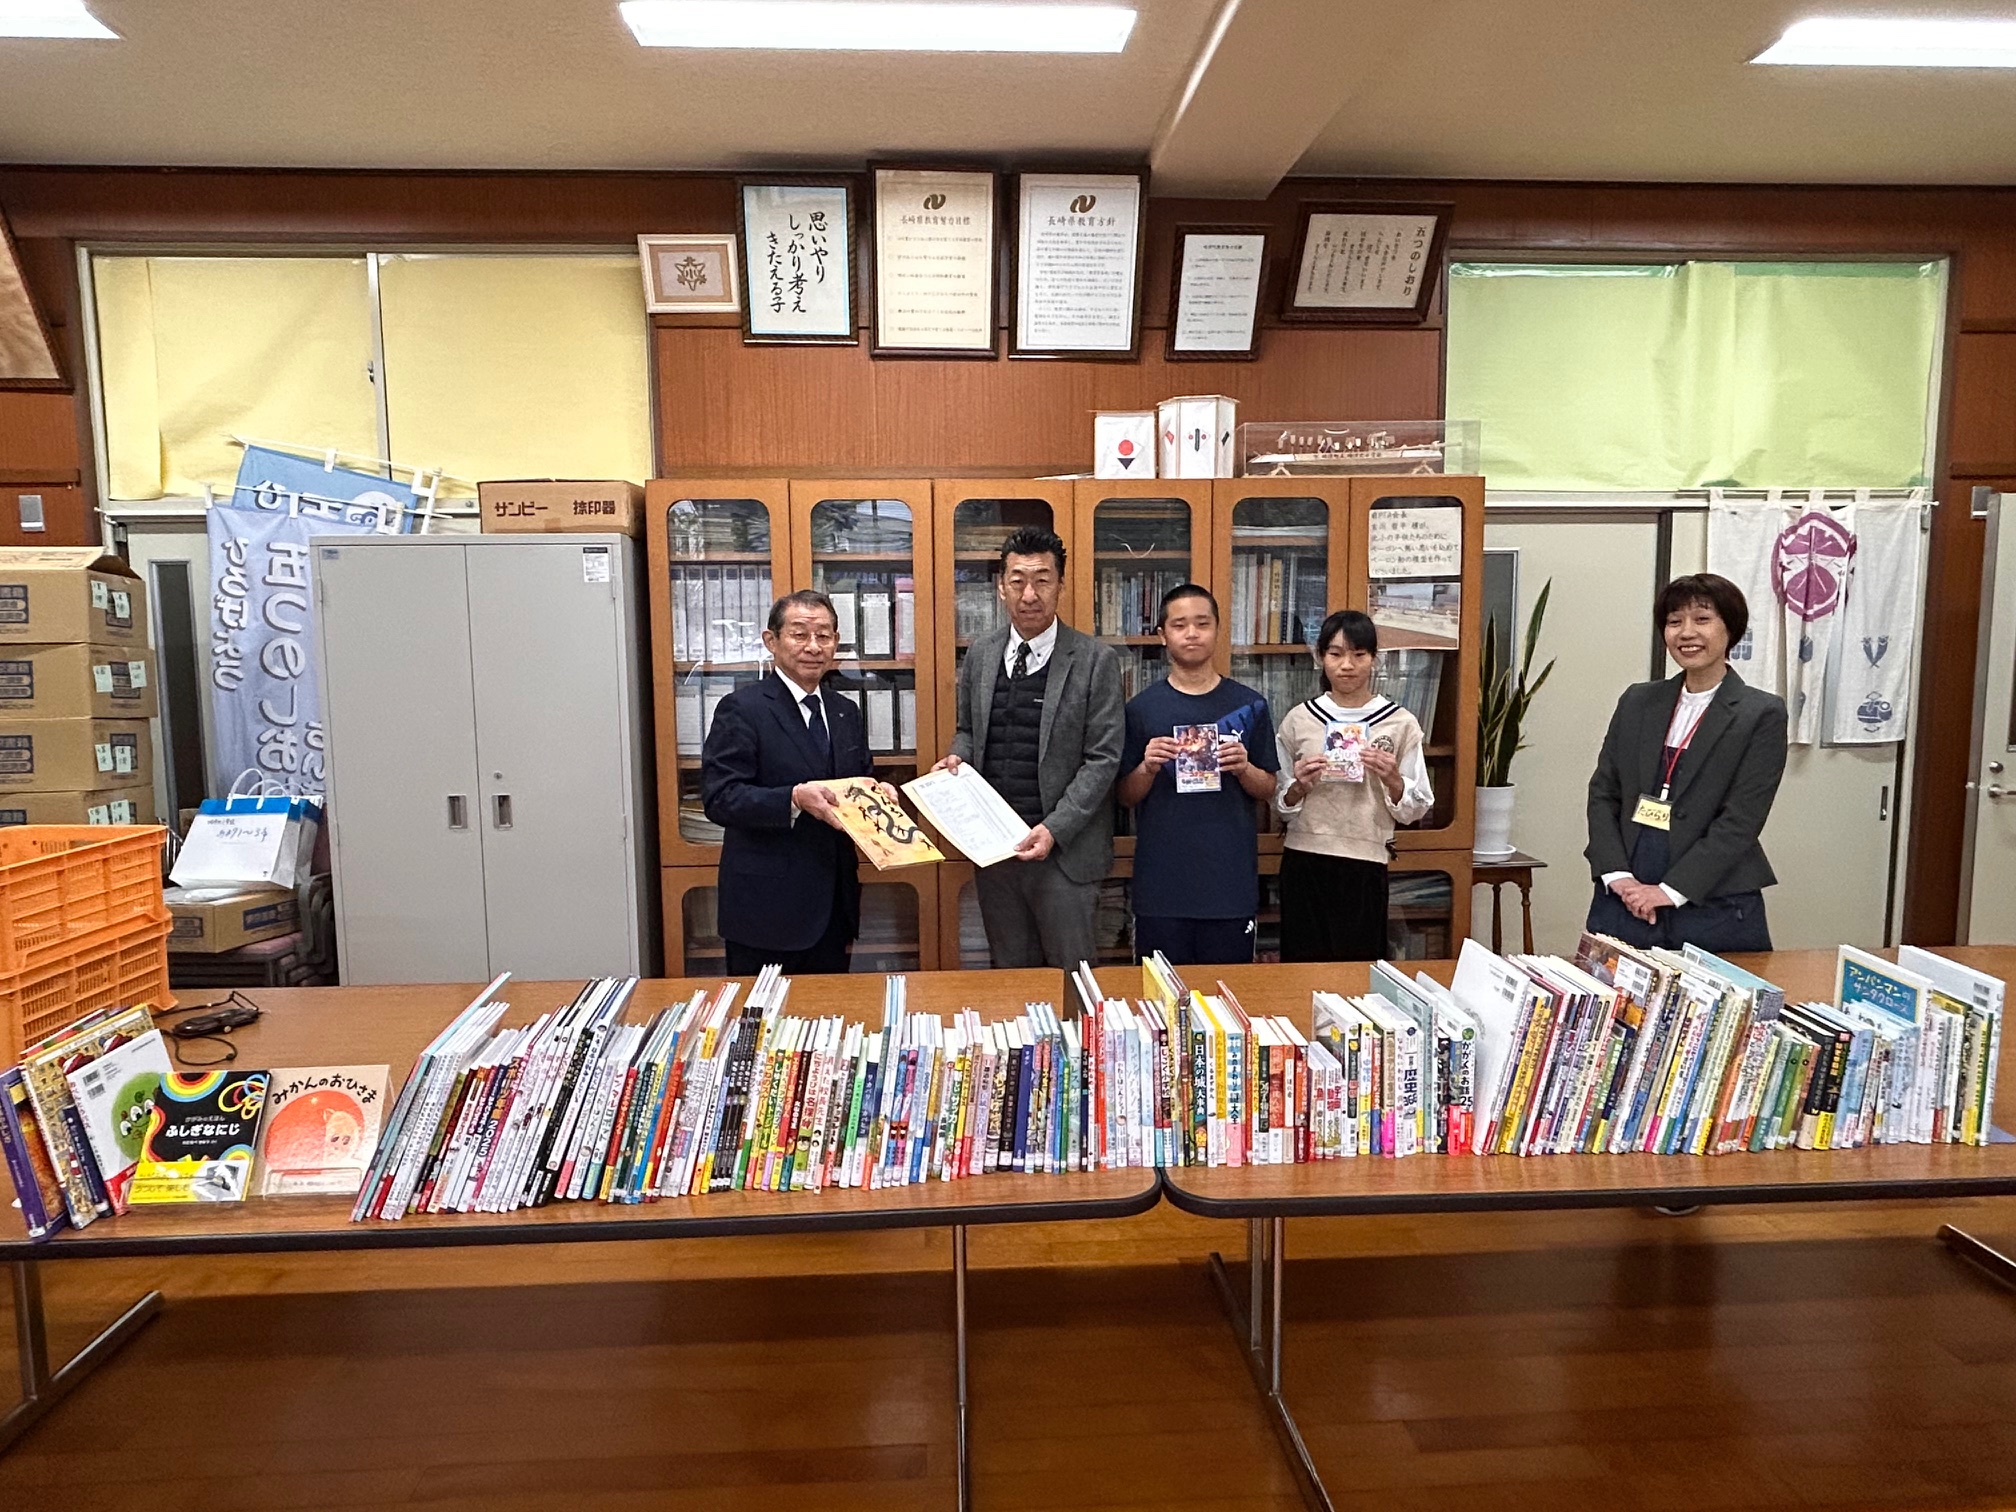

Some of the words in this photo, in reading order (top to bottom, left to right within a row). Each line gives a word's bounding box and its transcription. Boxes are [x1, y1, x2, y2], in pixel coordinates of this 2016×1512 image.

[807, 211, 829, 284] 思いやり
[1046, 216, 1116, 227] 長崎県教育方針
[765, 231, 786, 314] きたえる子
[786, 213, 807, 314] しっかり考え
[1402, 226, 1426, 297] 五つのしおり
[494, 500, 549, 517] サンビー
[572, 499, 616, 517] 捺印器
[1848, 966, 1911, 1001] アンパンマンの
[1853, 982, 1909, 1014] サンタクロース
[271, 1073, 379, 1105] みかんのおひさま
[801, 1052, 823, 1130] にちようびは名探偵
[815, 1055, 835, 1126] 消えた校長先生
[1193, 1044, 1207, 1116] 日本の城大事典
[165, 1123, 241, 1138] ふしぎなにじ
[478, 1119, 500, 1157] 2025
